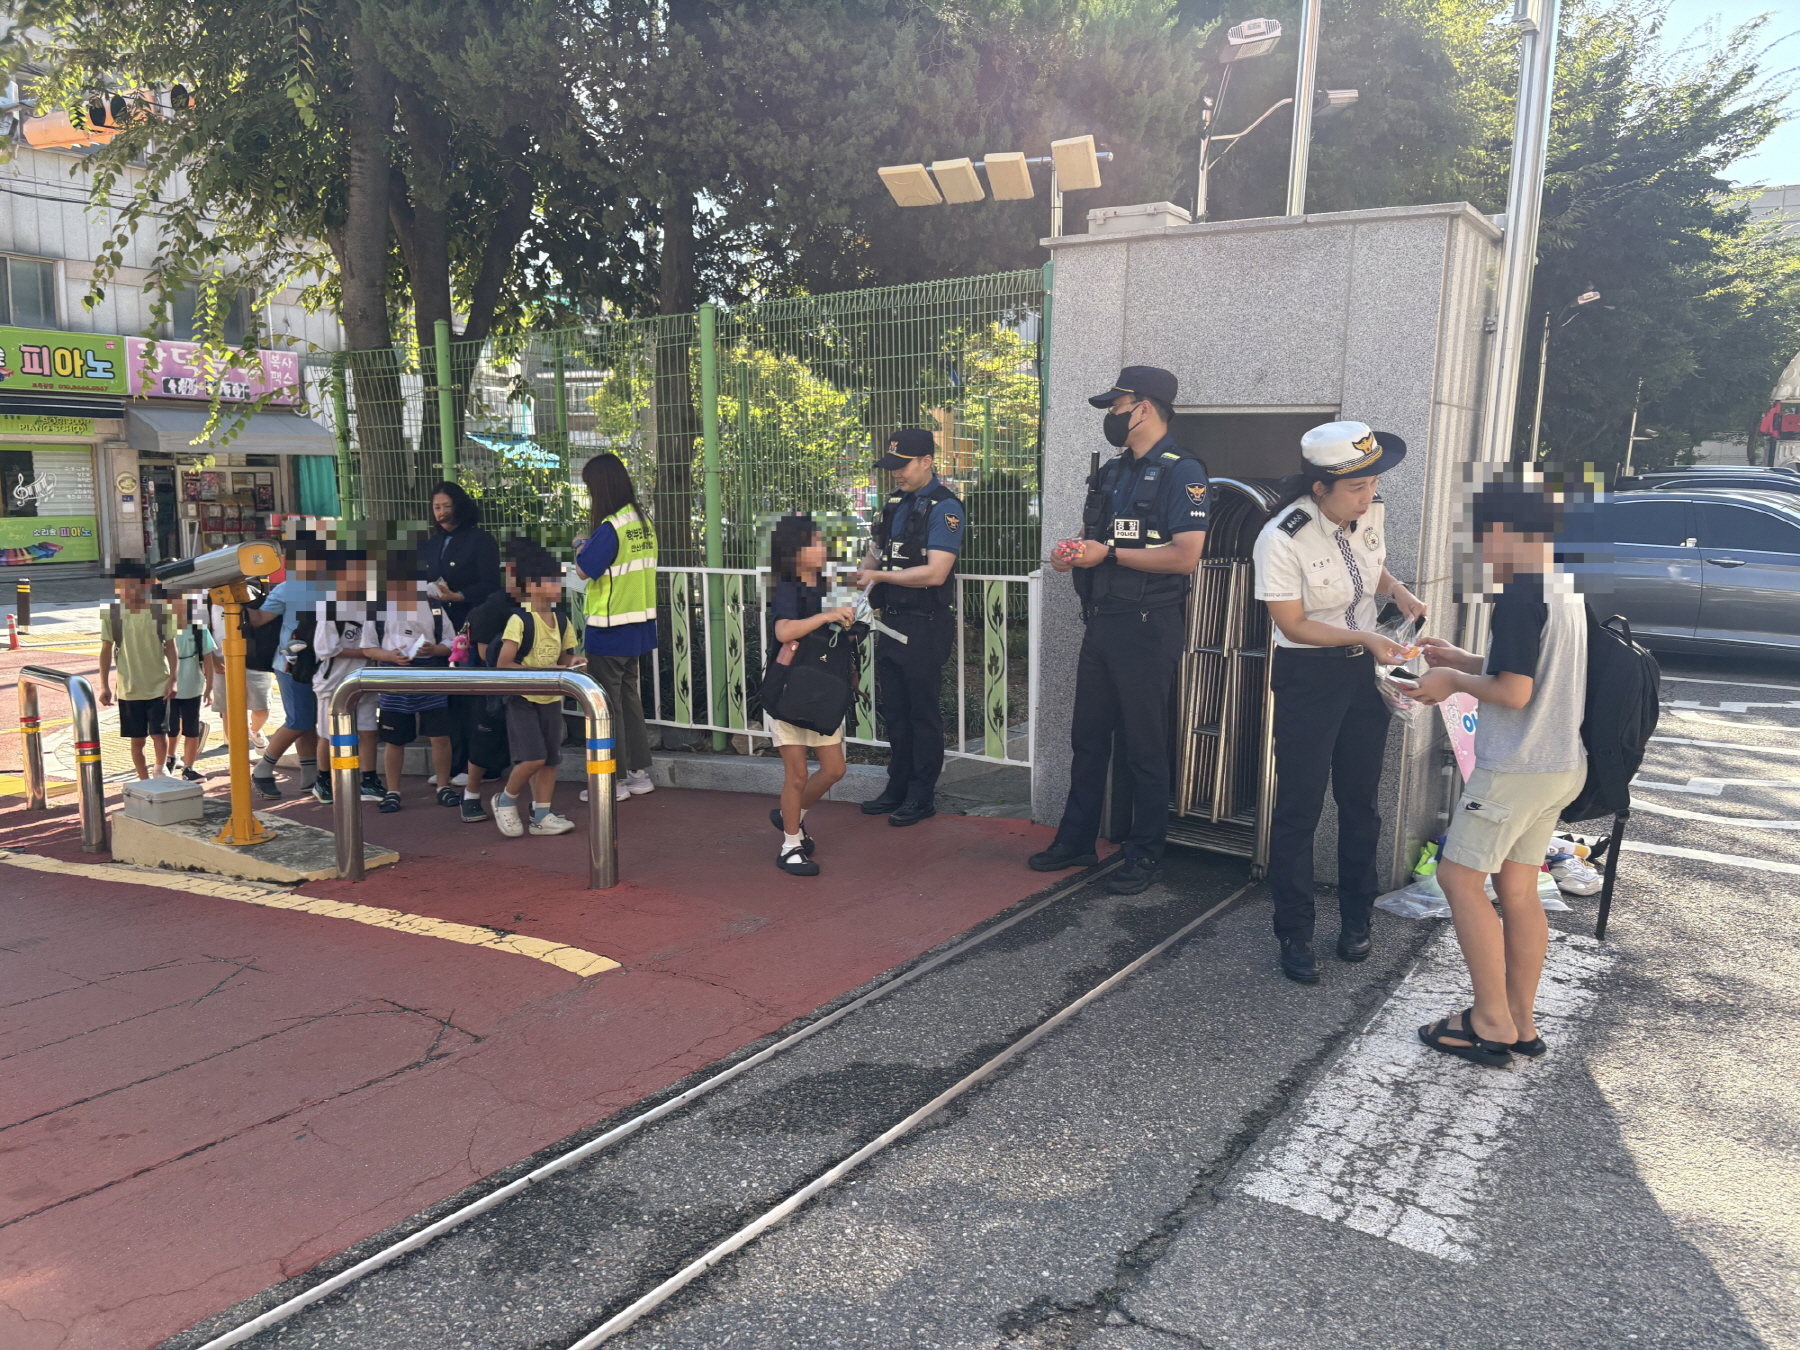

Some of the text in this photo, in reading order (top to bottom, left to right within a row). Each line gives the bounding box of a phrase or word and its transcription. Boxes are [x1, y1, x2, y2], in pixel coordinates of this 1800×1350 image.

[19, 344, 115, 379] 피아노
[270, 355, 293, 369] 복사
[270, 371, 294, 385] 팩스
[20, 424, 50, 432] PIANO
[59, 527, 92, 537] 피아노
